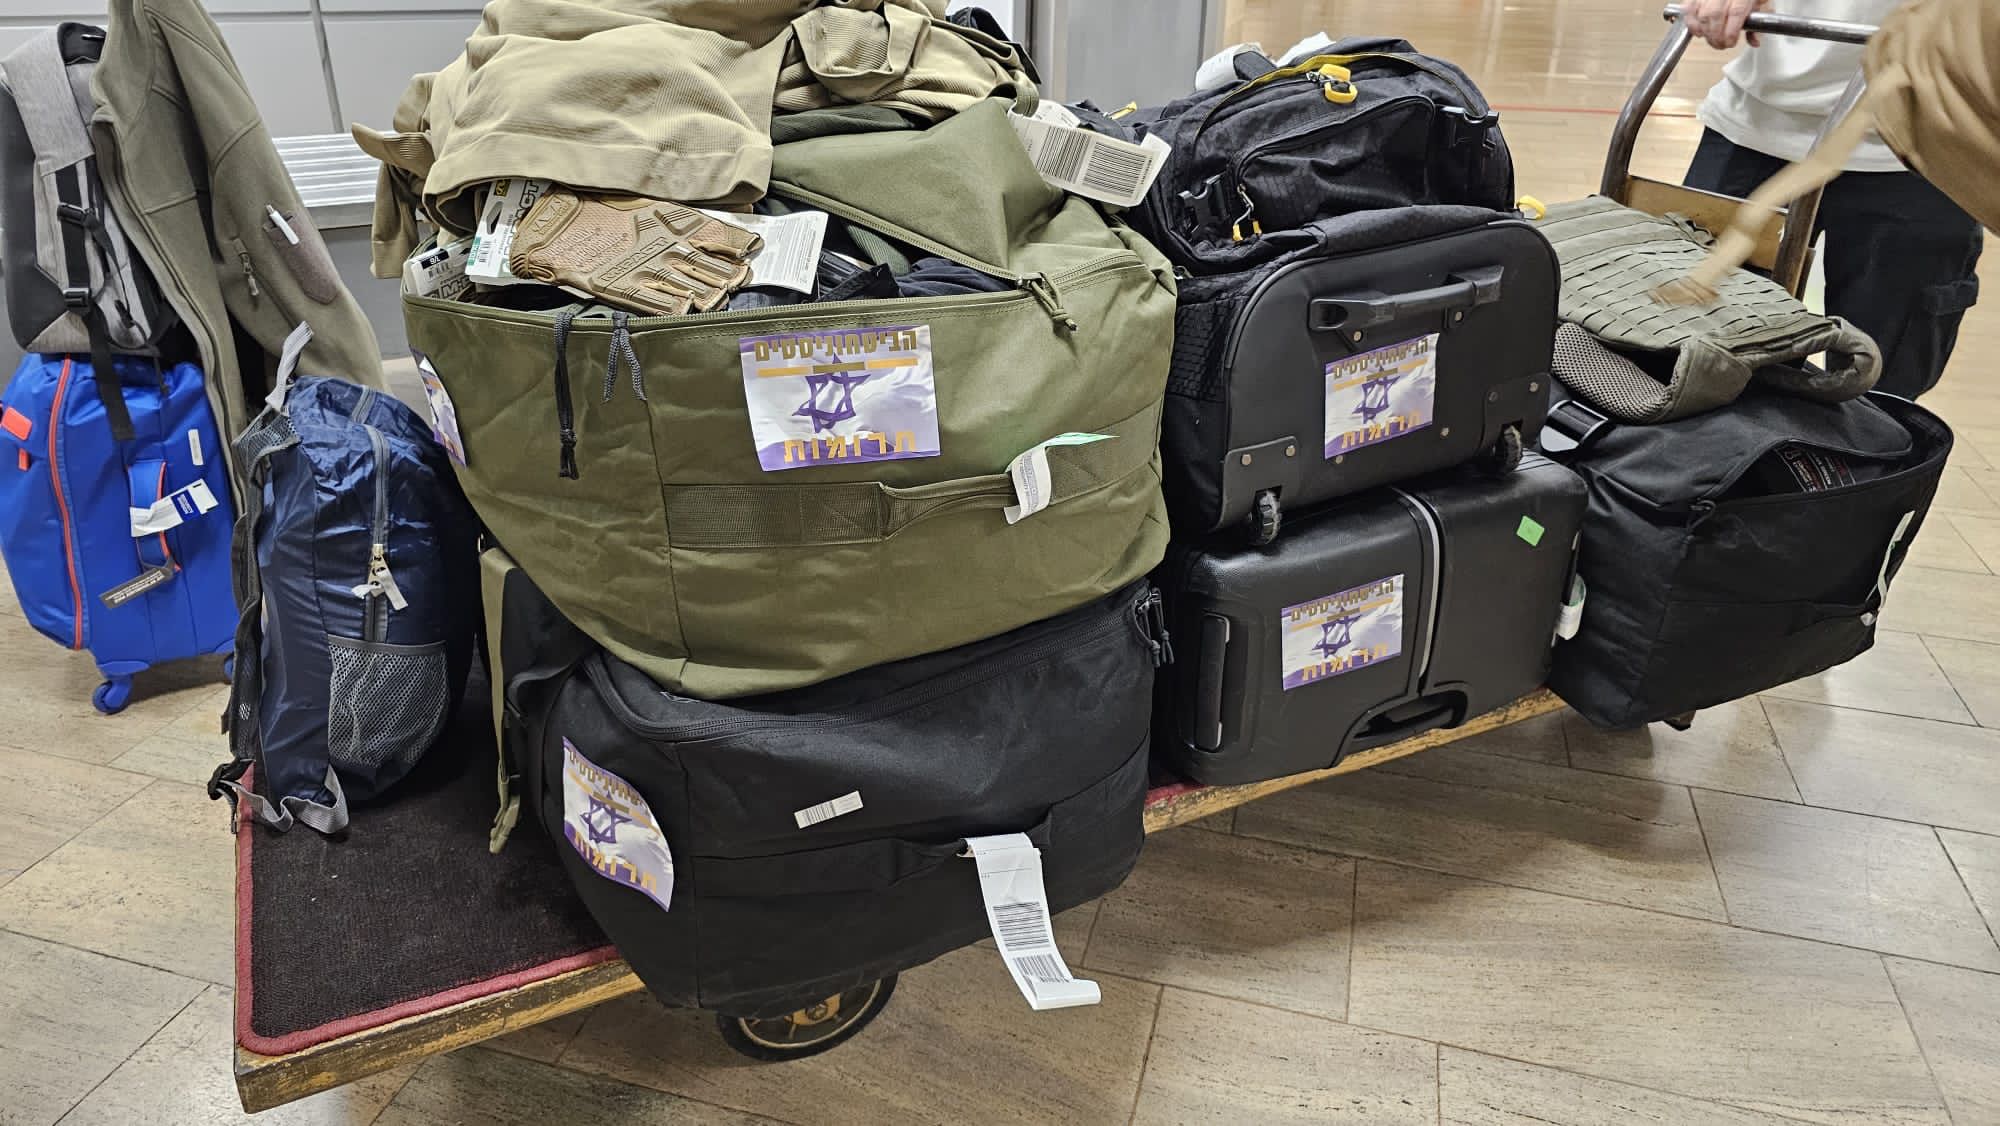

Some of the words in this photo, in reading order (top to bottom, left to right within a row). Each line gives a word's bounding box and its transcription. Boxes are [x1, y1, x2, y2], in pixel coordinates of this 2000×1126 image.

[754, 330, 917, 361] הביטחוניסטים
[1342, 410, 1421, 449] תרומות
[783, 431, 917, 464] תרומות
[1302, 643, 1388, 681] תרומות
